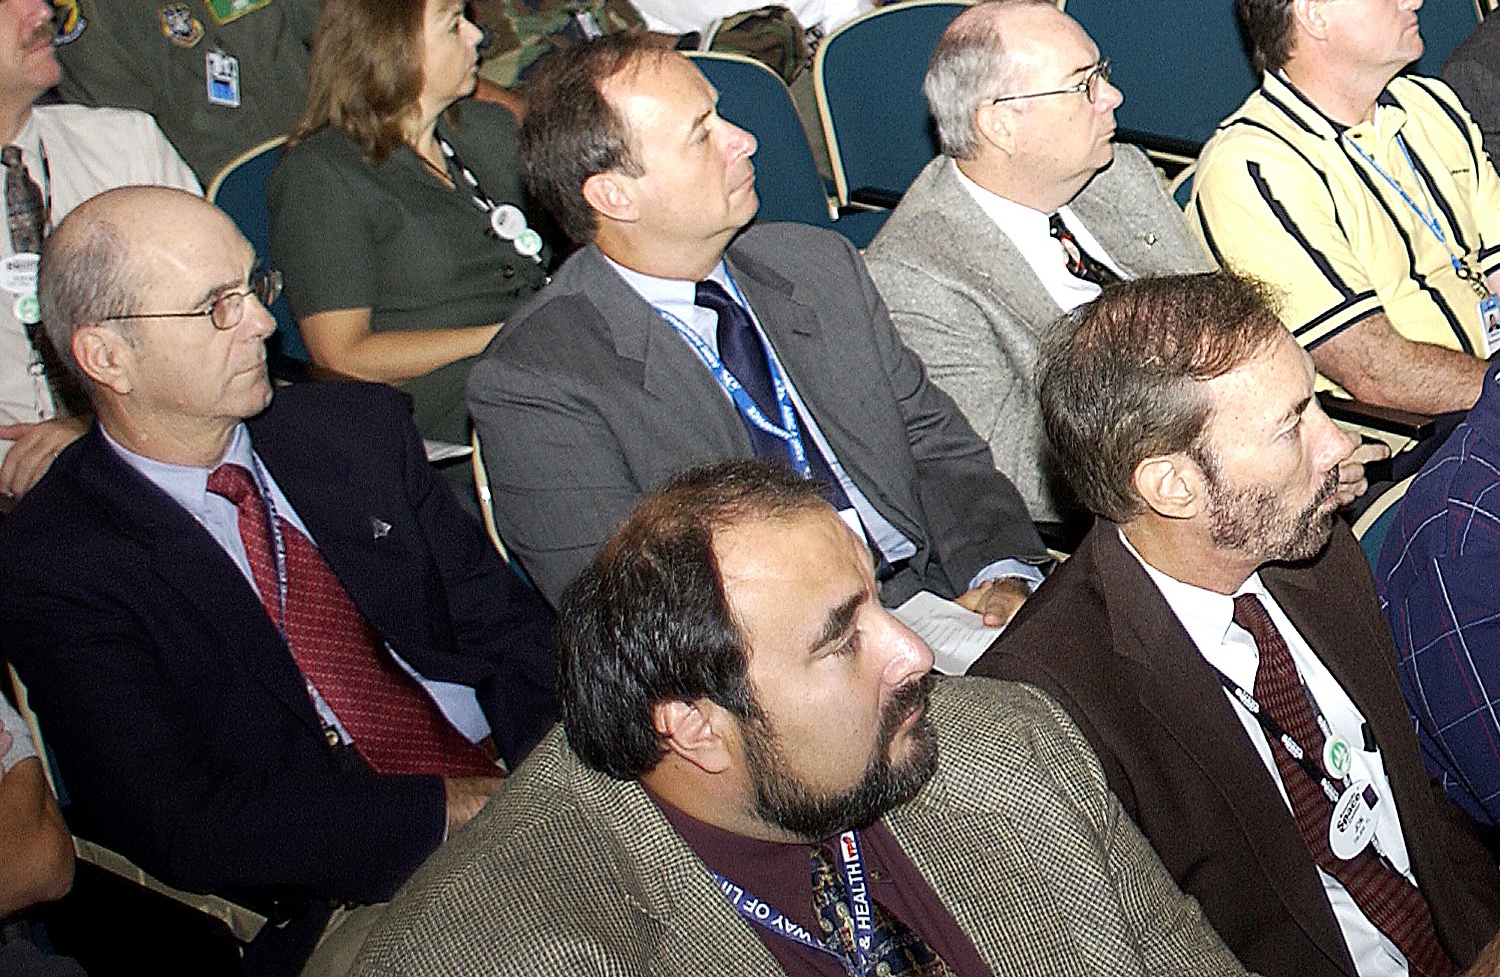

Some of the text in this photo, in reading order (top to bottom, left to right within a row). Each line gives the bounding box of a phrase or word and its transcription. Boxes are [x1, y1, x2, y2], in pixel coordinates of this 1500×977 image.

[846, 862, 871, 930] HEALTH
[743, 898, 771, 920] OF
[771, 914, 812, 943] WAY
[858, 935, 871, 950] &
